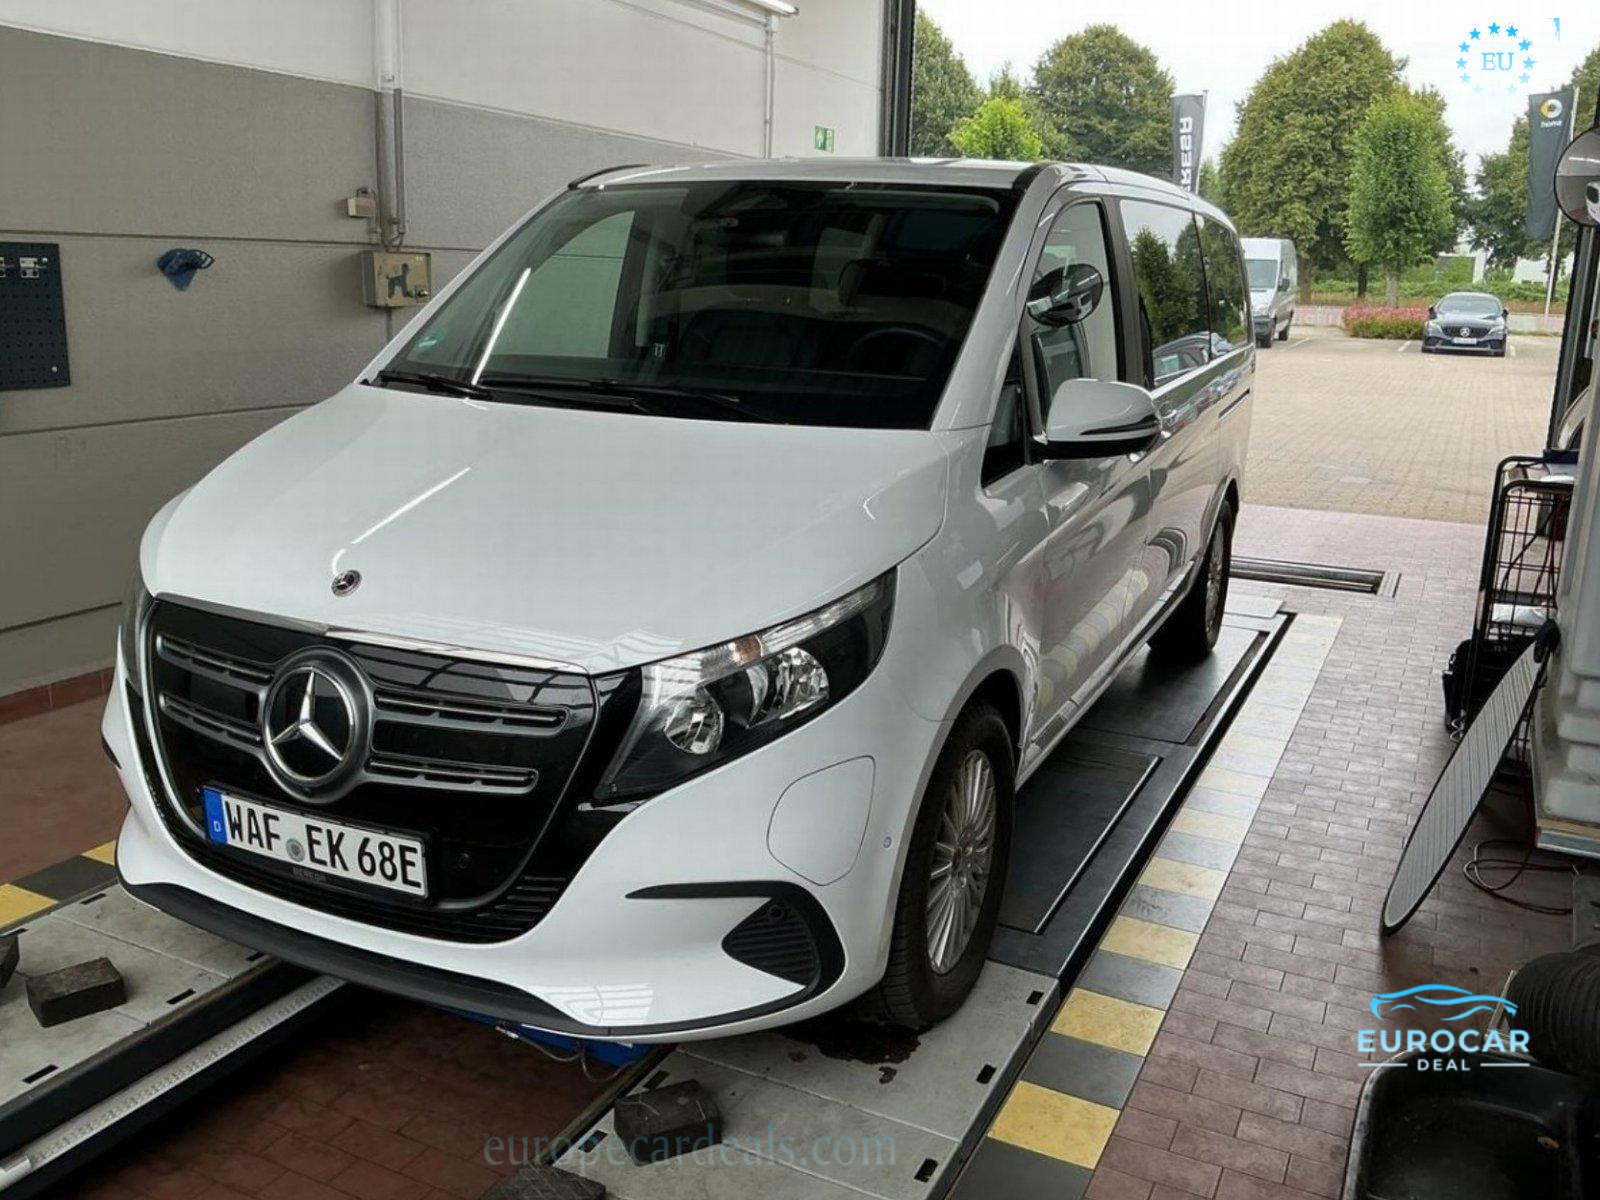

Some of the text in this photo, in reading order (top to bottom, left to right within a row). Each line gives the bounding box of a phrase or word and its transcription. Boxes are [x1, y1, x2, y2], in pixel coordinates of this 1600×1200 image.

[213, 820, 221, 832] D
[225, 801, 422, 888] WAF EK 68E
